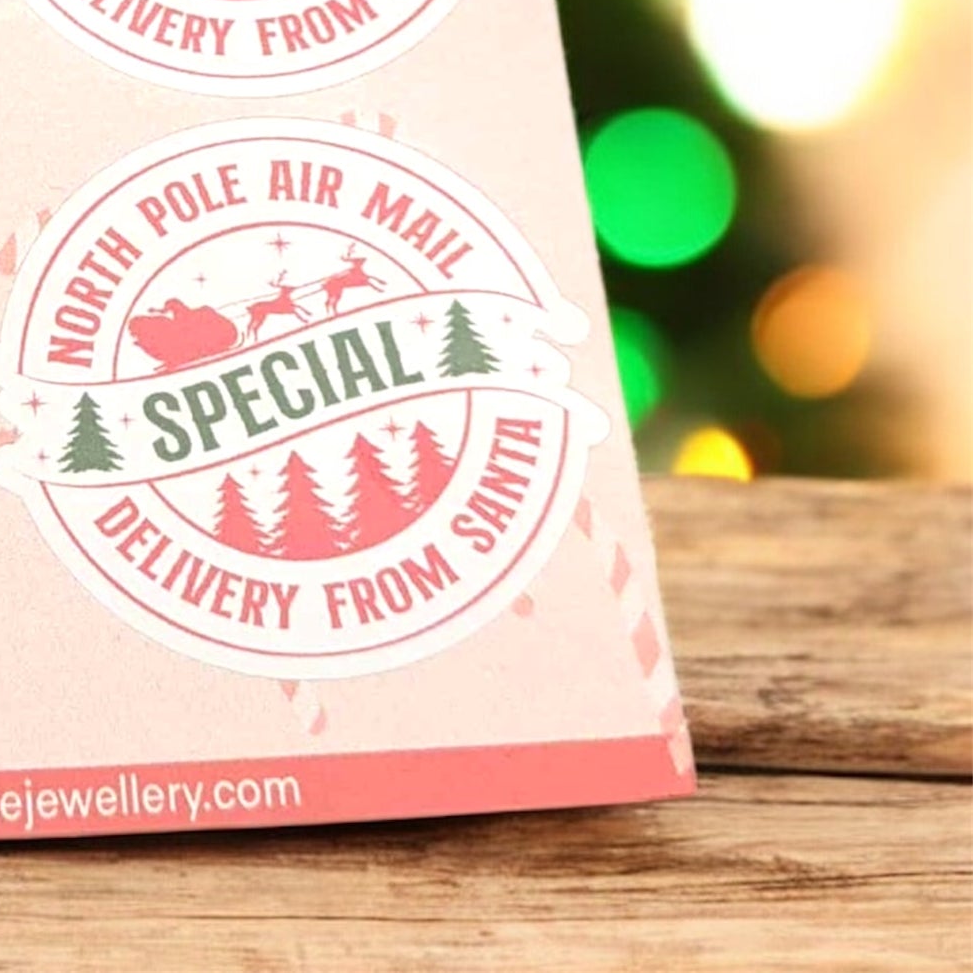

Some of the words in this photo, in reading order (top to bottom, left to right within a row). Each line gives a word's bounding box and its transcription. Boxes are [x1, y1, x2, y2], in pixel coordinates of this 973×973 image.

[47, 227, 143, 368] NORTH
[137, 164, 247, 237] POLE
[268, 160, 344, 209] AIR
[361, 181, 473, 279] MAIL
[143, 321, 424, 463] SPECIAL
[93, 495, 299, 629] DELIVERY
[323, 543, 461, 628] FROM
[450, 417, 543, 554] SANTA
